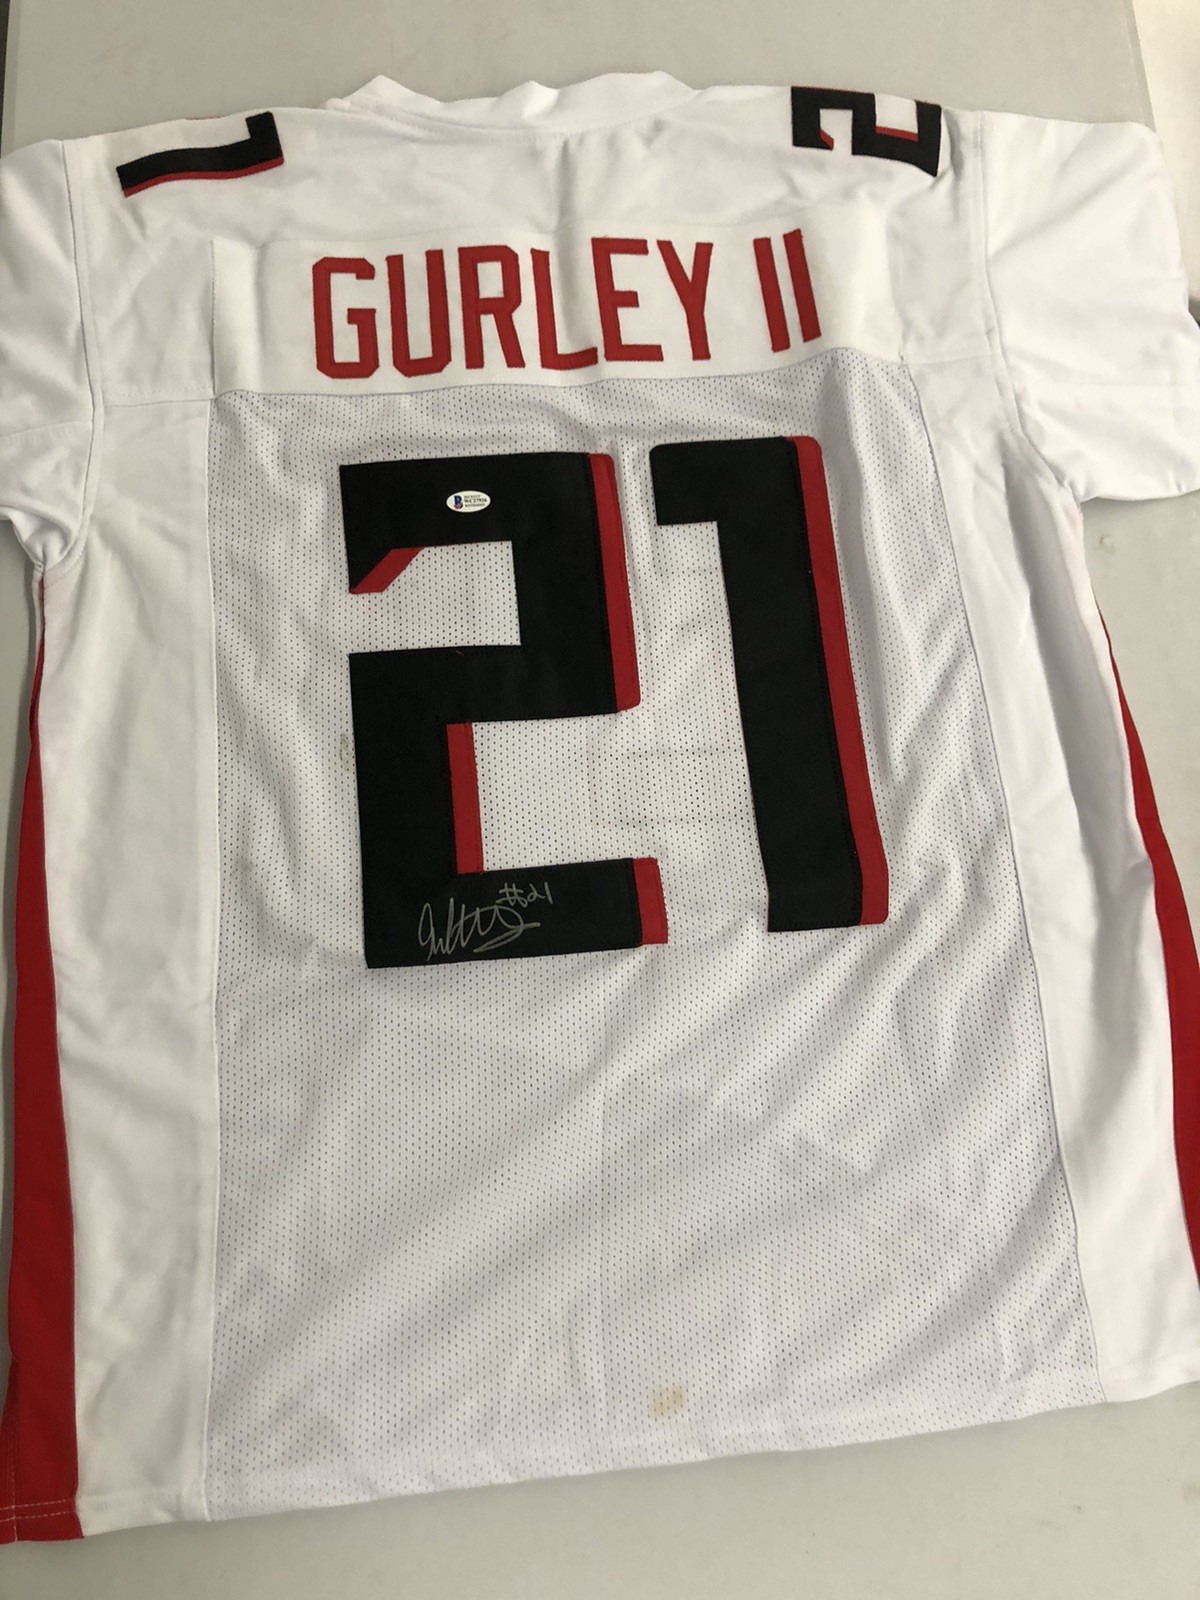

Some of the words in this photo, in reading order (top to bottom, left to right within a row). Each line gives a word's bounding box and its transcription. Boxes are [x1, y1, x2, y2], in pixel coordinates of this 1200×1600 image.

[312, 236, 714, 379] GURLEY
[753, 228, 822, 353] II
[339, 436, 889, 968] 21
